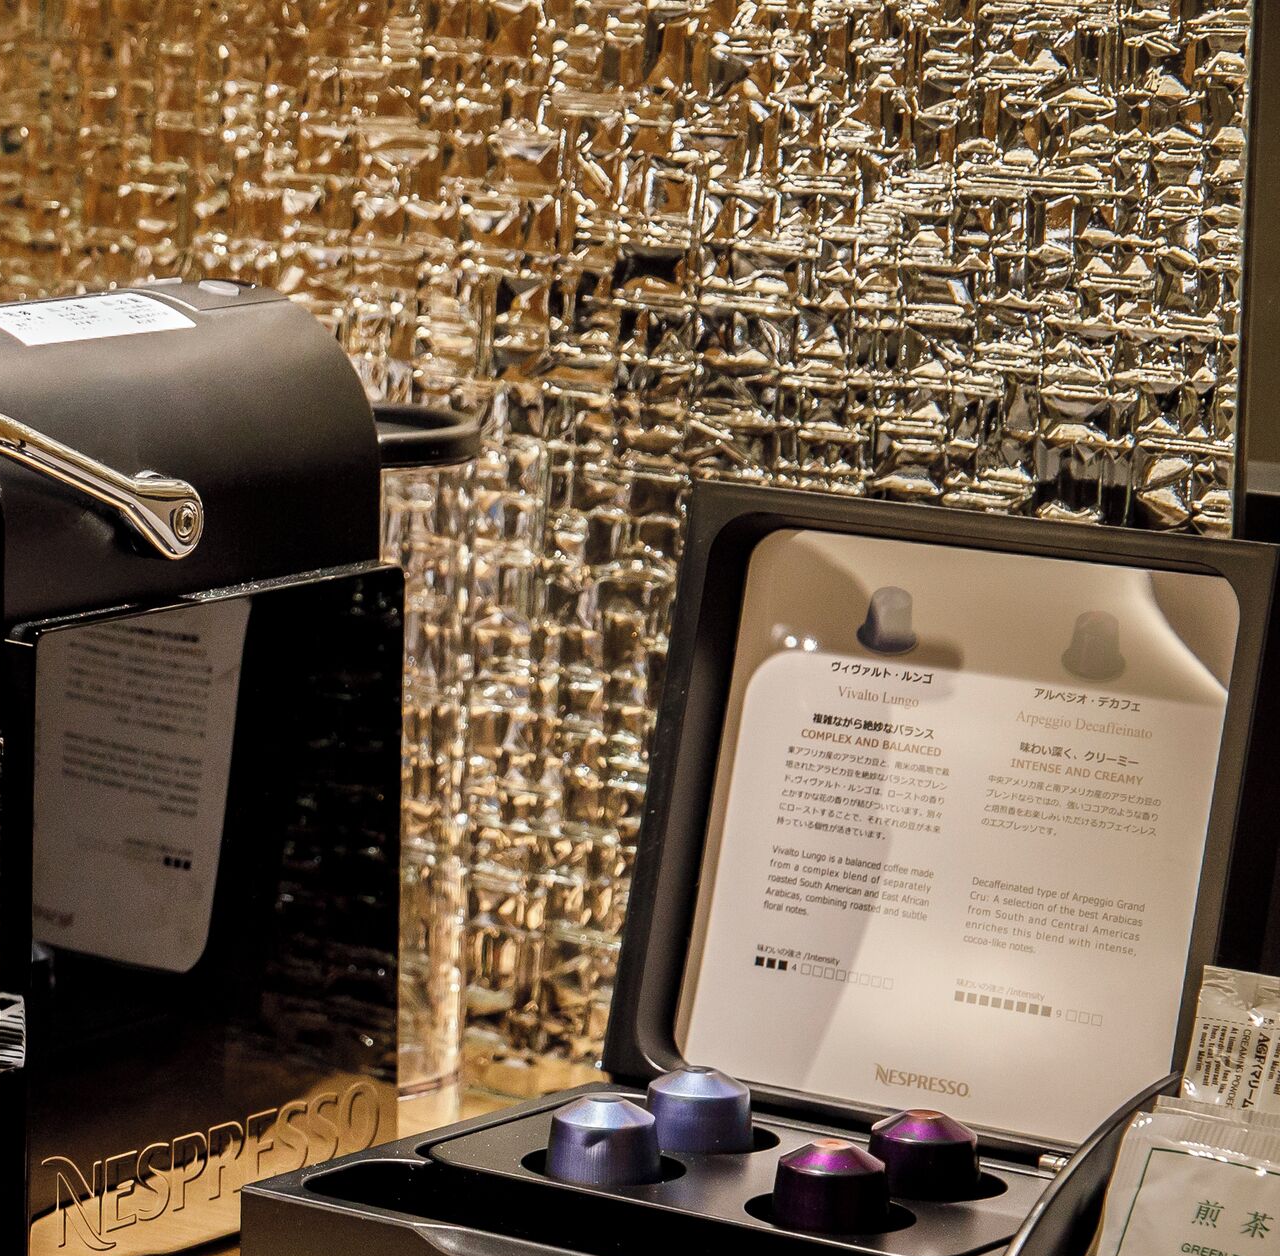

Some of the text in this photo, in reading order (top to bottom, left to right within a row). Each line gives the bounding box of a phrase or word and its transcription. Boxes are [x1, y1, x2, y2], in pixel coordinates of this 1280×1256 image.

[831, 661, 934, 684] ヴィヴァルト・ルンゴ
[838, 686, 919, 709] Vivalto Lungo
[813, 713, 935, 739] 複雑ながら絶妙なバランス
[1016, 710, 1153, 739] Arpeggio Decaffeinato
[801, 729, 942, 757] COMPLEX AND BALANCED
[1019, 742, 1139, 767] 味わい深く、クリーミー
[1010, 758, 1144, 786] INTENSE AND CREAMY
[769, 859, 791, 870] from
[802, 865, 840, 878] complex
[843, 871, 867, 883] blend
[871, 875, 880, 884] of
[883, 878, 932, 894] separately
[772, 845, 800, 857] Vivalto
[801, 850, 826, 862] Lungo
[845, 857, 881, 870] balanced
[883, 863, 908, 874] coffee
[911, 868, 934, 879] made
[765, 887, 928, 921] Arabicas, combining roasted and subtle
[768, 873, 929, 907] roasted South American and East African
[972, 876, 1146, 913] Decaffeinated type of Arpeggio Grand
[763, 900, 783, 911] floral
[993, 895, 1000, 904] A
[1003, 897, 1044, 911] selection
[1047, 903, 1057, 913] of
[1059, 906, 1075, 917] the
[1078, 908, 1098, 920] best
[1102, 912, 1143, 927] Arabicas
[967, 905, 1141, 942] from South and Central Americas
[963, 934, 1007, 949] cocoa-like
[965, 921, 1137, 957] enriches this blend with intense,
[1056, 1010, 1062, 1018] 9
[1199, 1032, 1208, 1048] more
[874, 1062, 970, 1098] NESPRESSO
[42, 1081, 381, 1251] NESPRESSO
